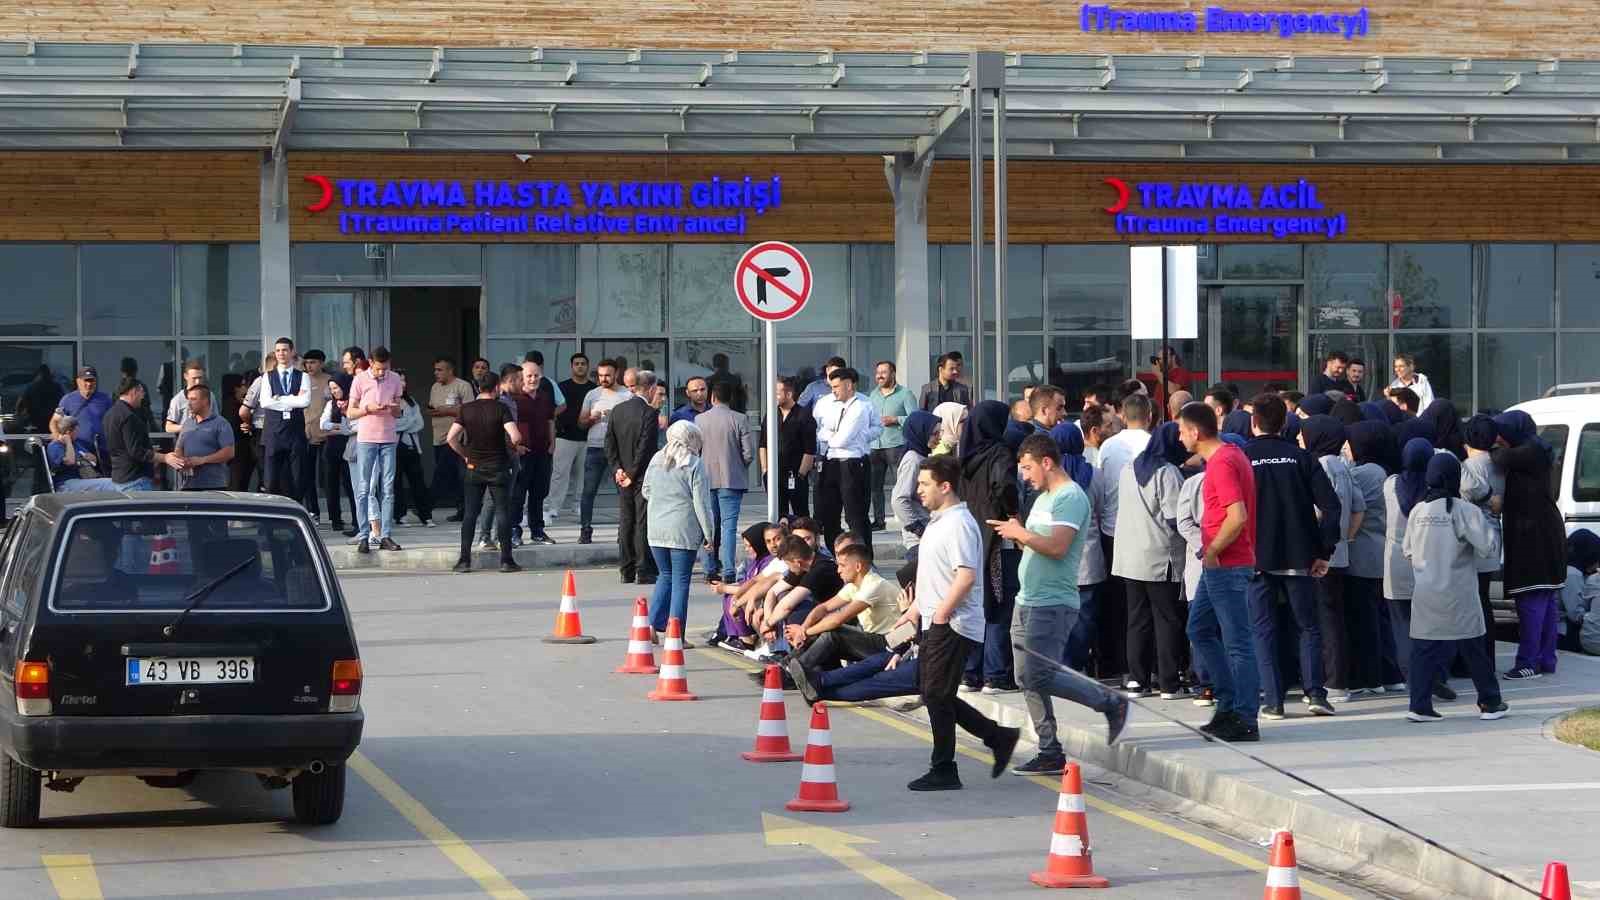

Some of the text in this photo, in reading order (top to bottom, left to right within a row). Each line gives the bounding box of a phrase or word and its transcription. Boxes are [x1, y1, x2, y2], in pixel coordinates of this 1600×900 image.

[337, 176, 782, 214] TRAVMA HASTA YAKINI GİRİŞİ
[1137, 178, 1325, 209] TRAVMA ACİL
[446, 211, 528, 233] Patient
[534, 211, 630, 233] Relative
[1251, 457, 1297, 466] EUROCLEAN
[146, 659, 249, 681] 43 VB 396
